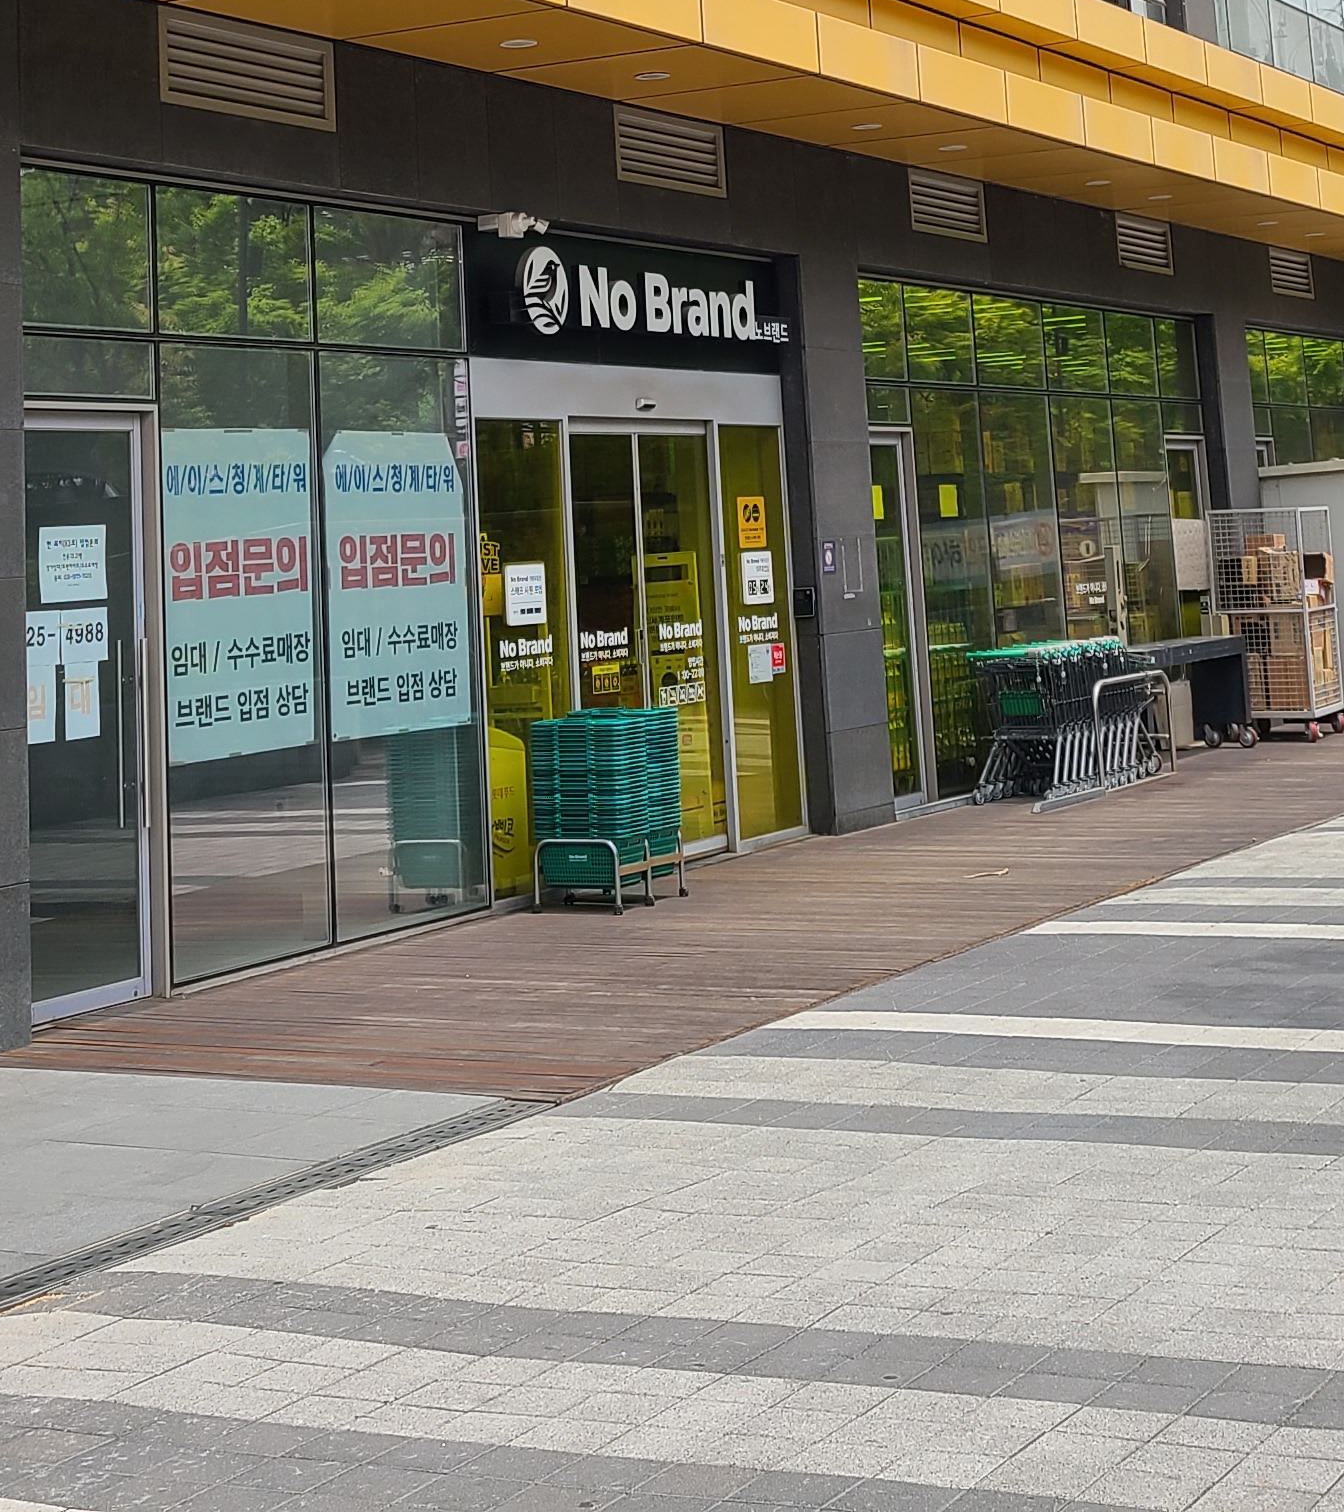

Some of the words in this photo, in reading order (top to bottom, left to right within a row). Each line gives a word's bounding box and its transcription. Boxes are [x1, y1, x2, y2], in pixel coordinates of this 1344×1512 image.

[578, 264, 636, 331] No
[644, 271, 756, 340] Brand
[755, 322, 789, 343] 노브랜드
[170, 536, 308, 601] 입점문의
[339, 533, 456, 590] 입점문의
[341, 627, 371, 660] 임대
[387, 621, 458, 655] 수수료매장
[580, 632, 595, 649] No
[597, 627, 628, 647] Brand
[659, 623, 673, 640] No
[674, 619, 702, 638] Brand
[738, 616, 751, 632] No
[751, 613, 778, 630] Brand
[171, 641, 207, 677] 임대
[227, 631, 310, 670] 수수료매장
[500, 639, 517, 658] No
[518, 635, 553, 657] Brand
[175, 695, 232, 728] 브랜드
[237, 687, 269, 722] 입점
[276, 683, 308, 716] 상담
[346, 676, 392, 707] 브랜드
[396, 671, 424, 703] 입점
[428, 668, 457, 699] 상담
